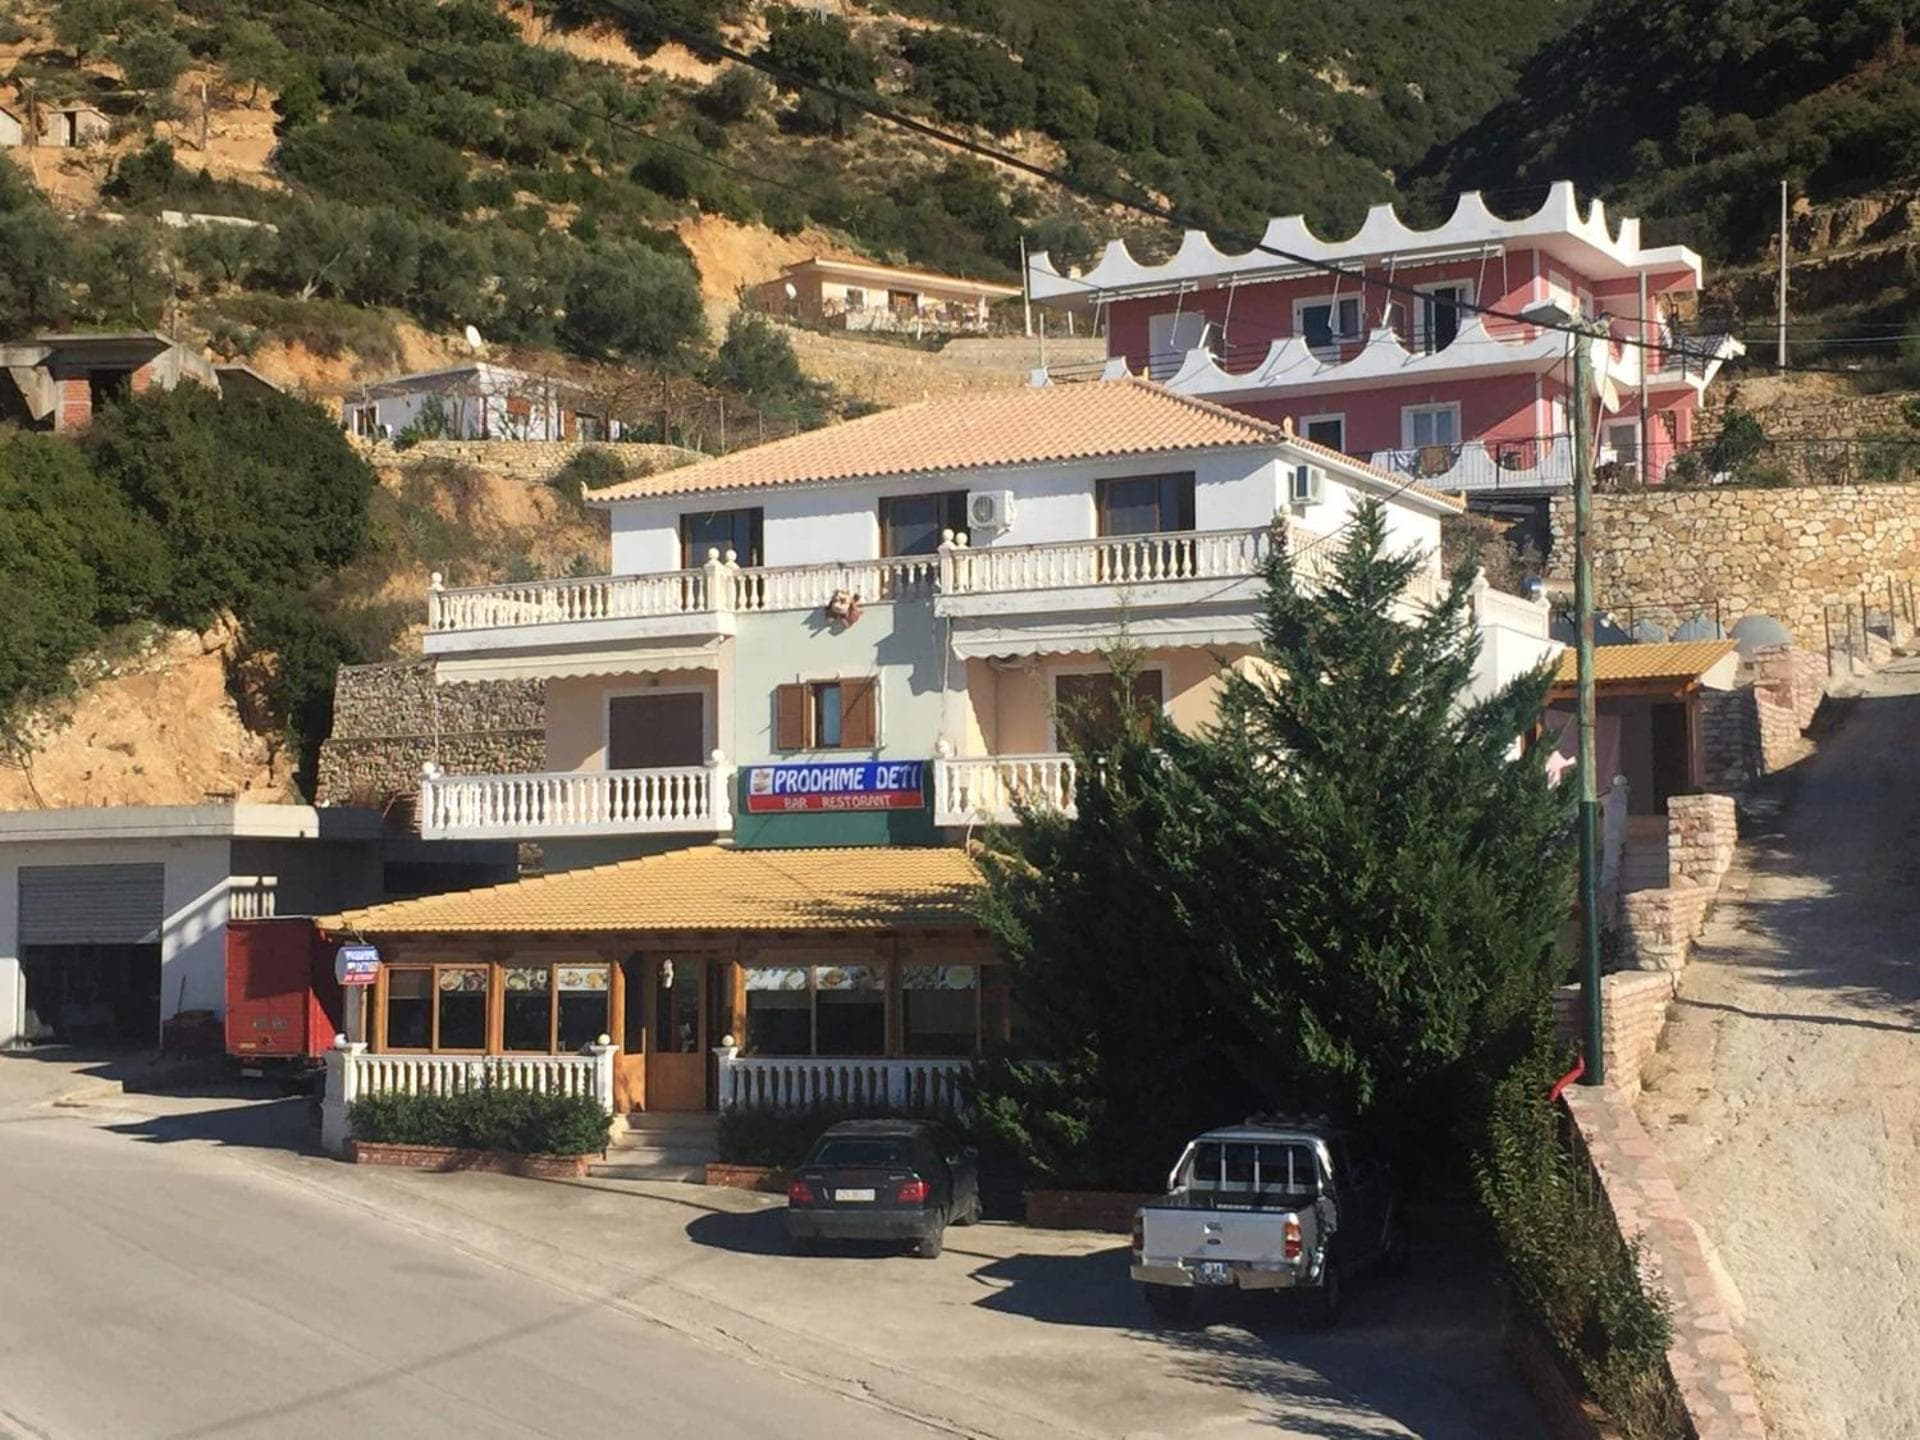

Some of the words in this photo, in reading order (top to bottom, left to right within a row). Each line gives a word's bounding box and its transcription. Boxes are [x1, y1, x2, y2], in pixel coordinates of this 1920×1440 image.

[775, 767, 865, 793] PRODHIME
[876, 765, 917, 789] DETI
[784, 797, 808, 808] BAR
[822, 795, 892, 808] RESTORANT
